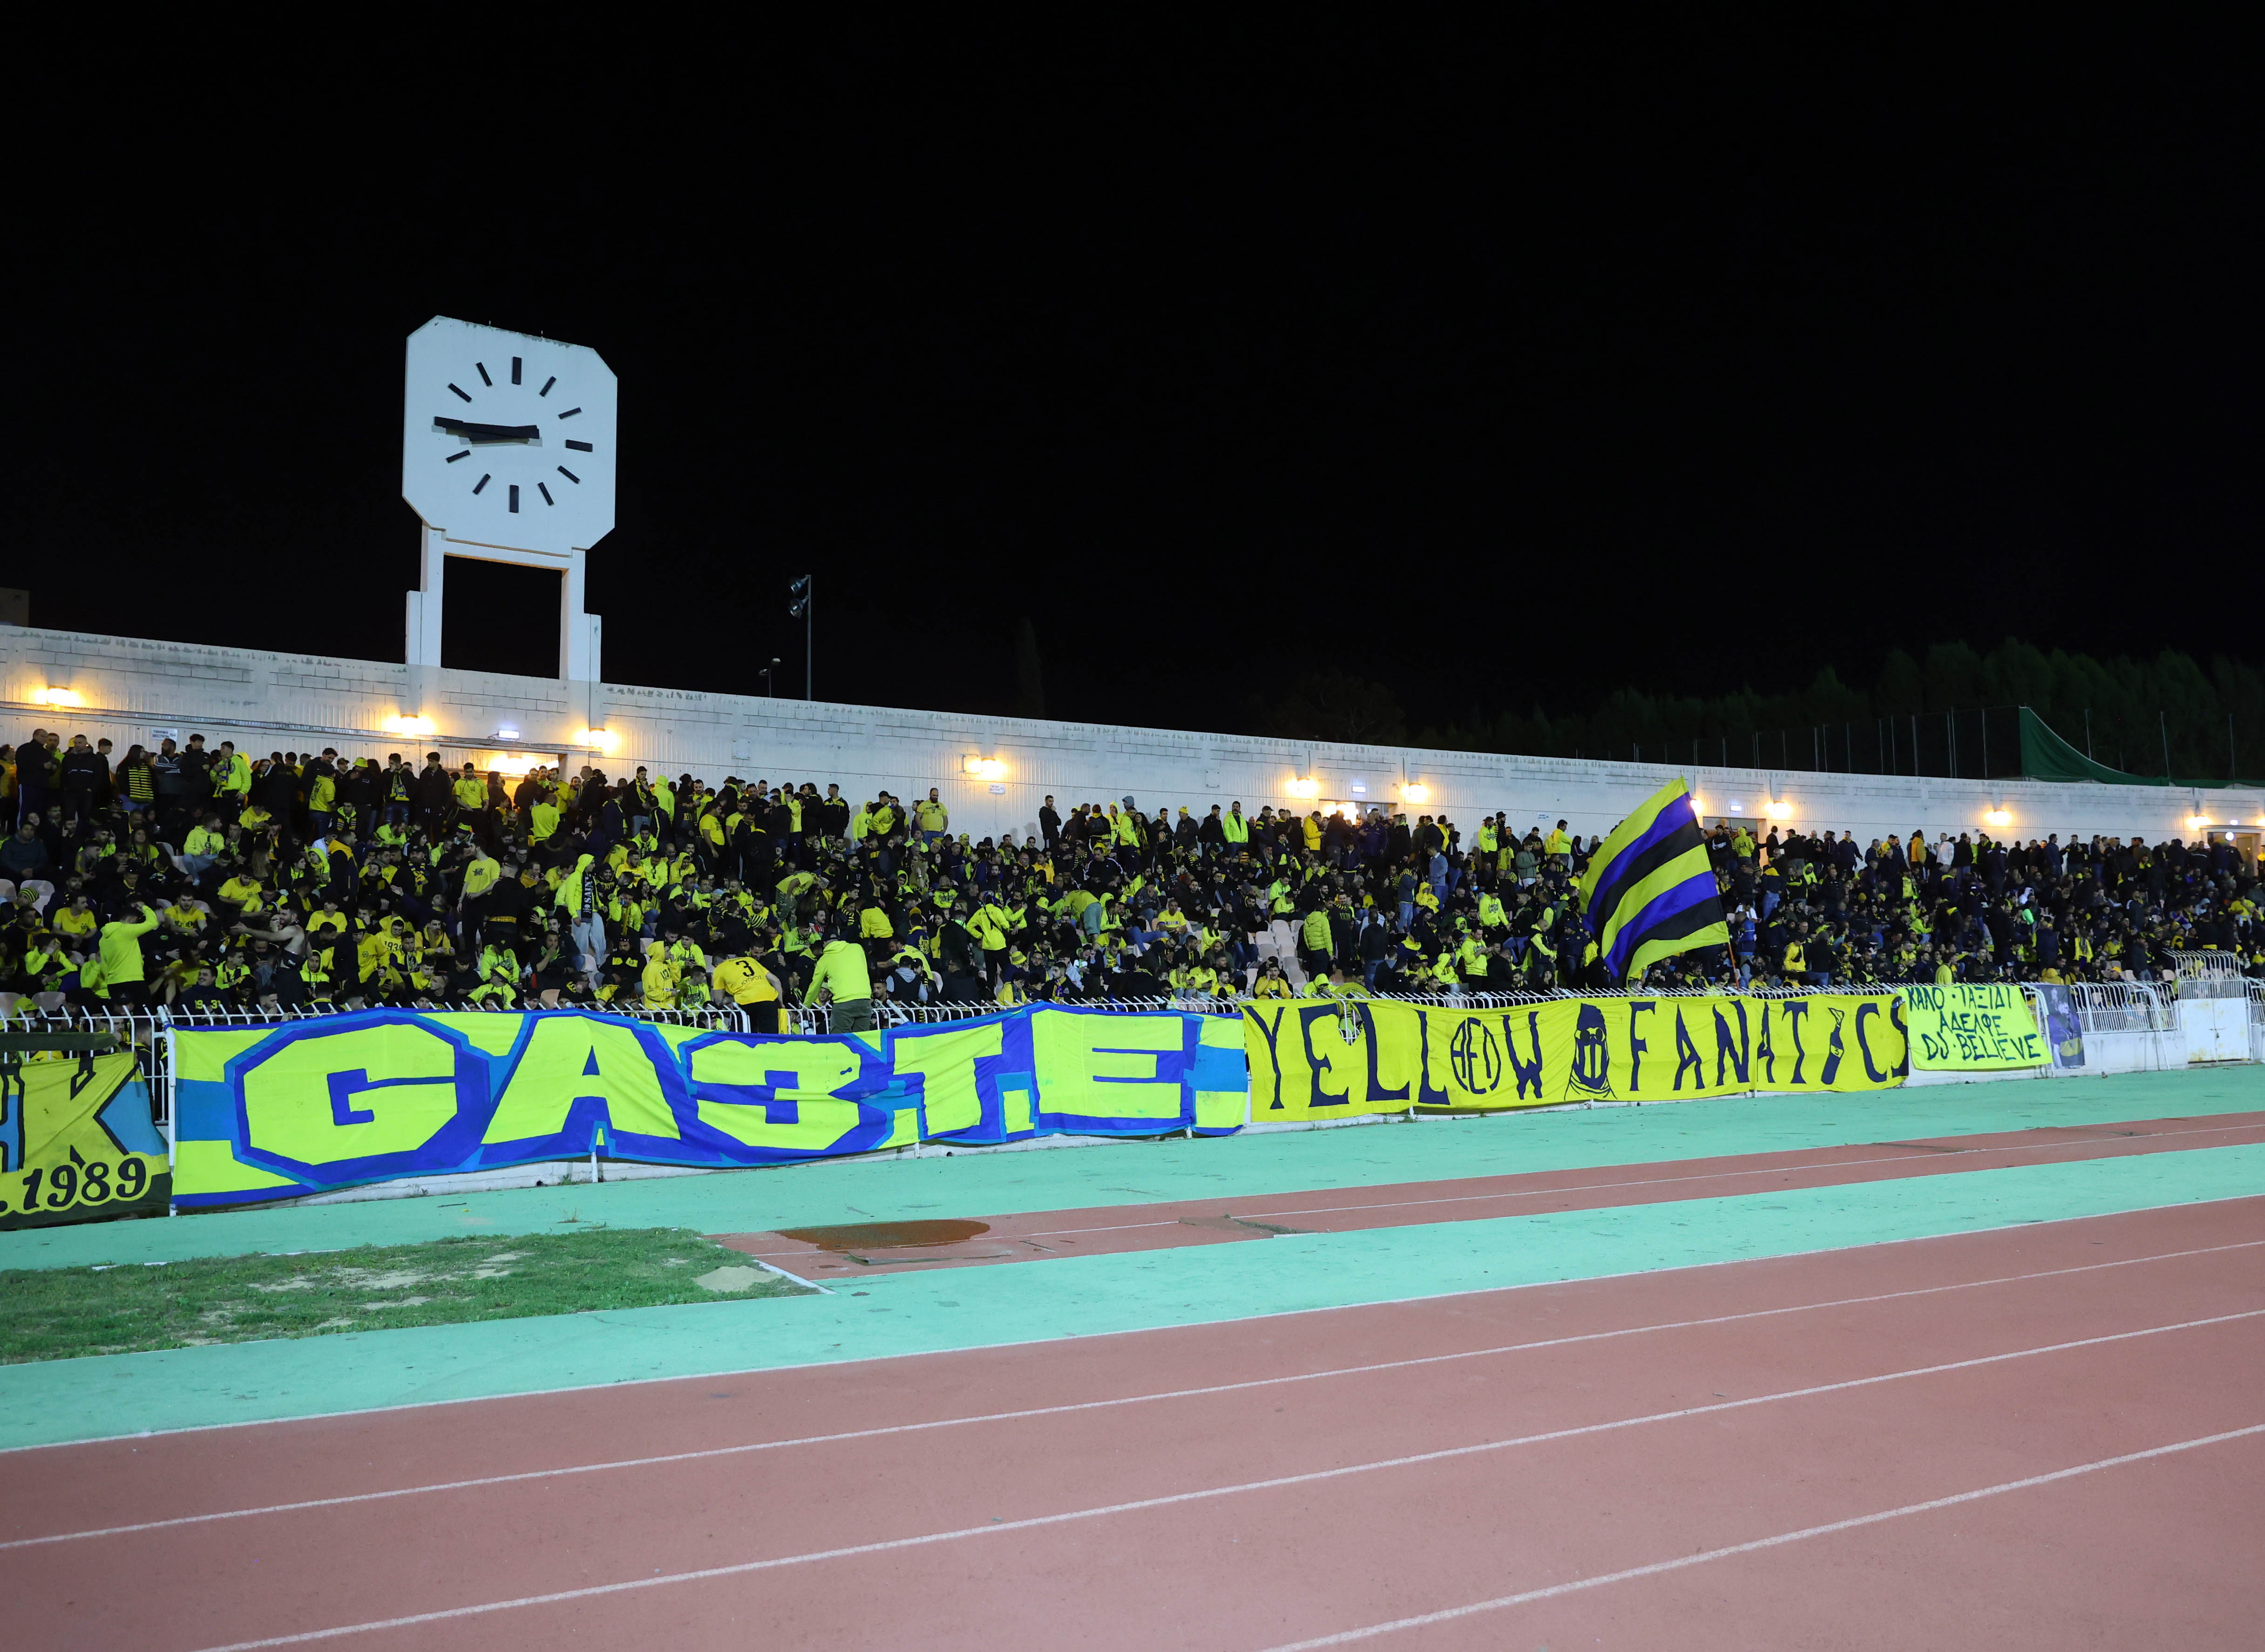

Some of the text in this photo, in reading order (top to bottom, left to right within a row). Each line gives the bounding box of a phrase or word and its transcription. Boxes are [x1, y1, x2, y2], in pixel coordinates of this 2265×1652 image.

[736, 961, 755, 977] 3
[1955, 1033, 2041, 1061] BELIEVE
[22, 1158, 146, 1211] 1989
